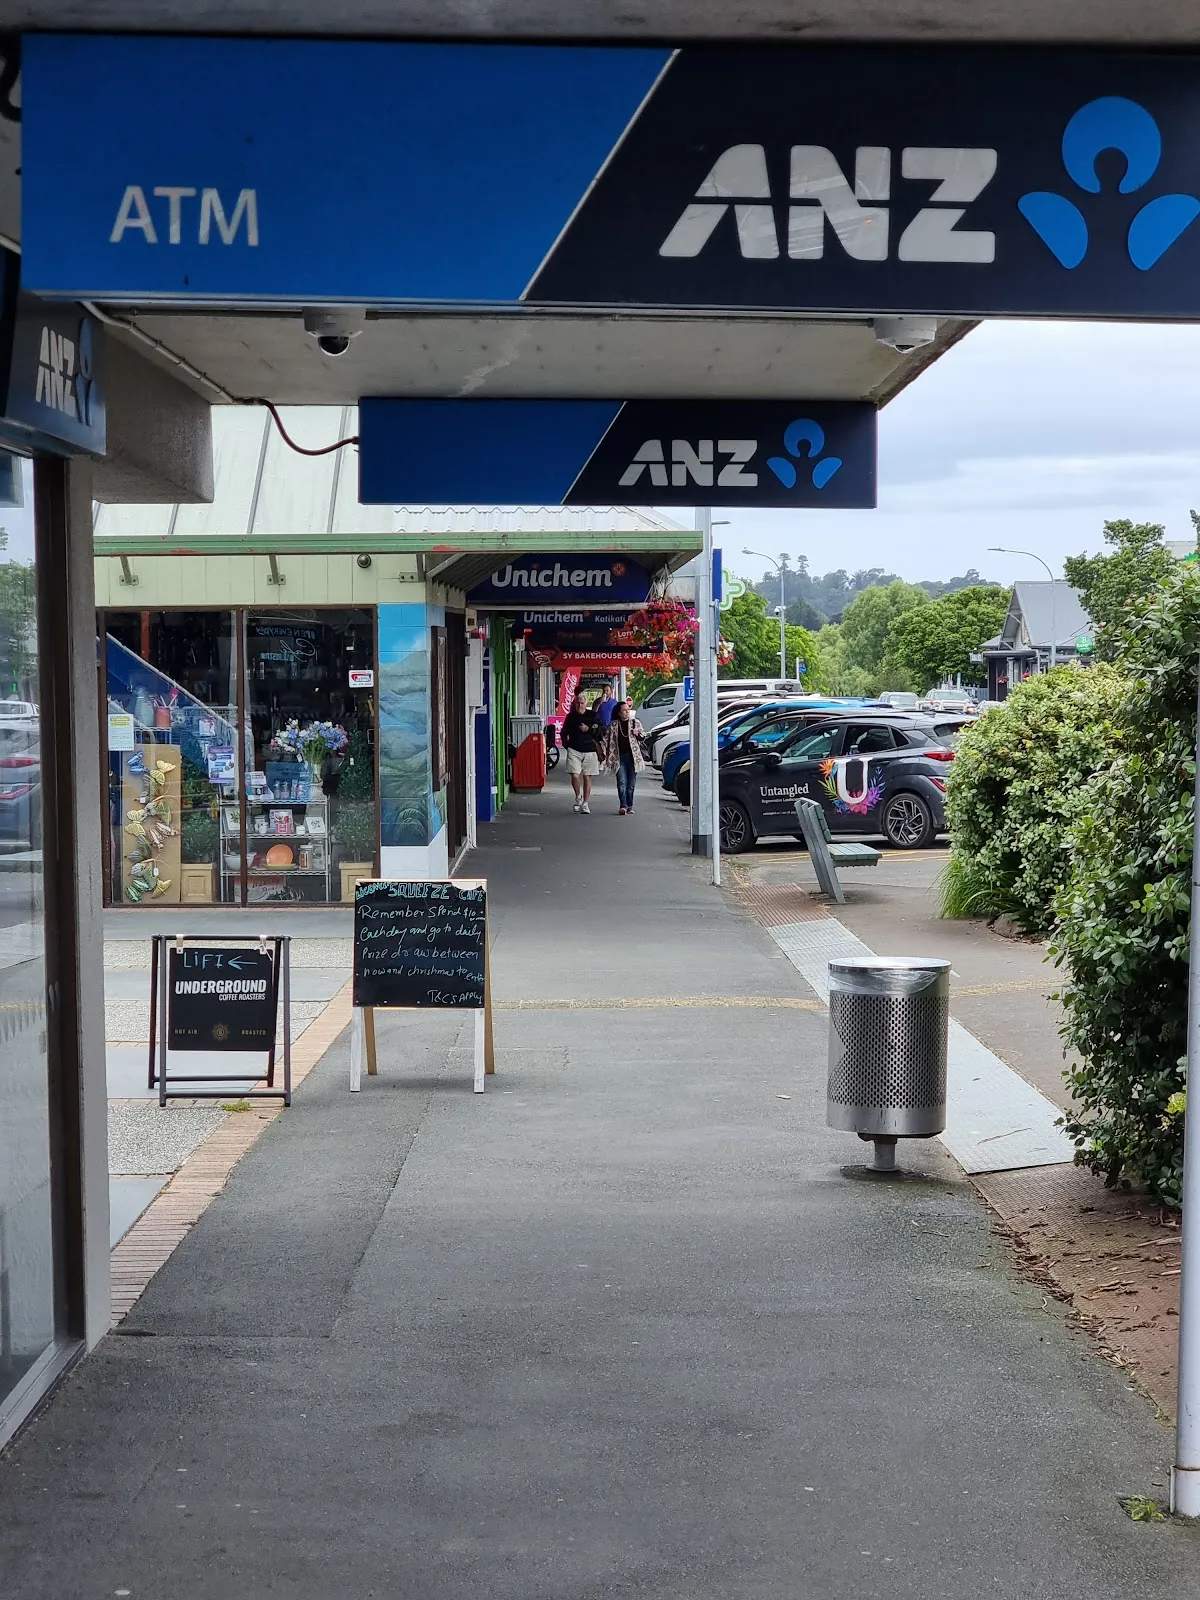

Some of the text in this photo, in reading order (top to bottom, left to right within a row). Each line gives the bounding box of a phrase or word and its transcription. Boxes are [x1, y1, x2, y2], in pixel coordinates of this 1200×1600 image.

[659, 143, 998, 264] ANZ
[109, 185, 259, 247] ATM
[36, 326, 77, 417] ANZ
[618, 439, 758, 487] ANZ
[491, 563, 613, 588] Unichem
[523, 611, 584, 623] Unichem
[575, 652, 623, 660] BAKEHOUSE
[760, 783, 810, 798] Untangled
[358, 904, 425, 920] Remember
[427, 927, 442, 943] go
[444, 922, 452, 933] to
[433, 946, 479, 960] between
[456, 964, 468, 977] to
[175, 980, 267, 995] UNDERGROUND
[219, 993, 266, 1001] COFFEE ROASTERS
